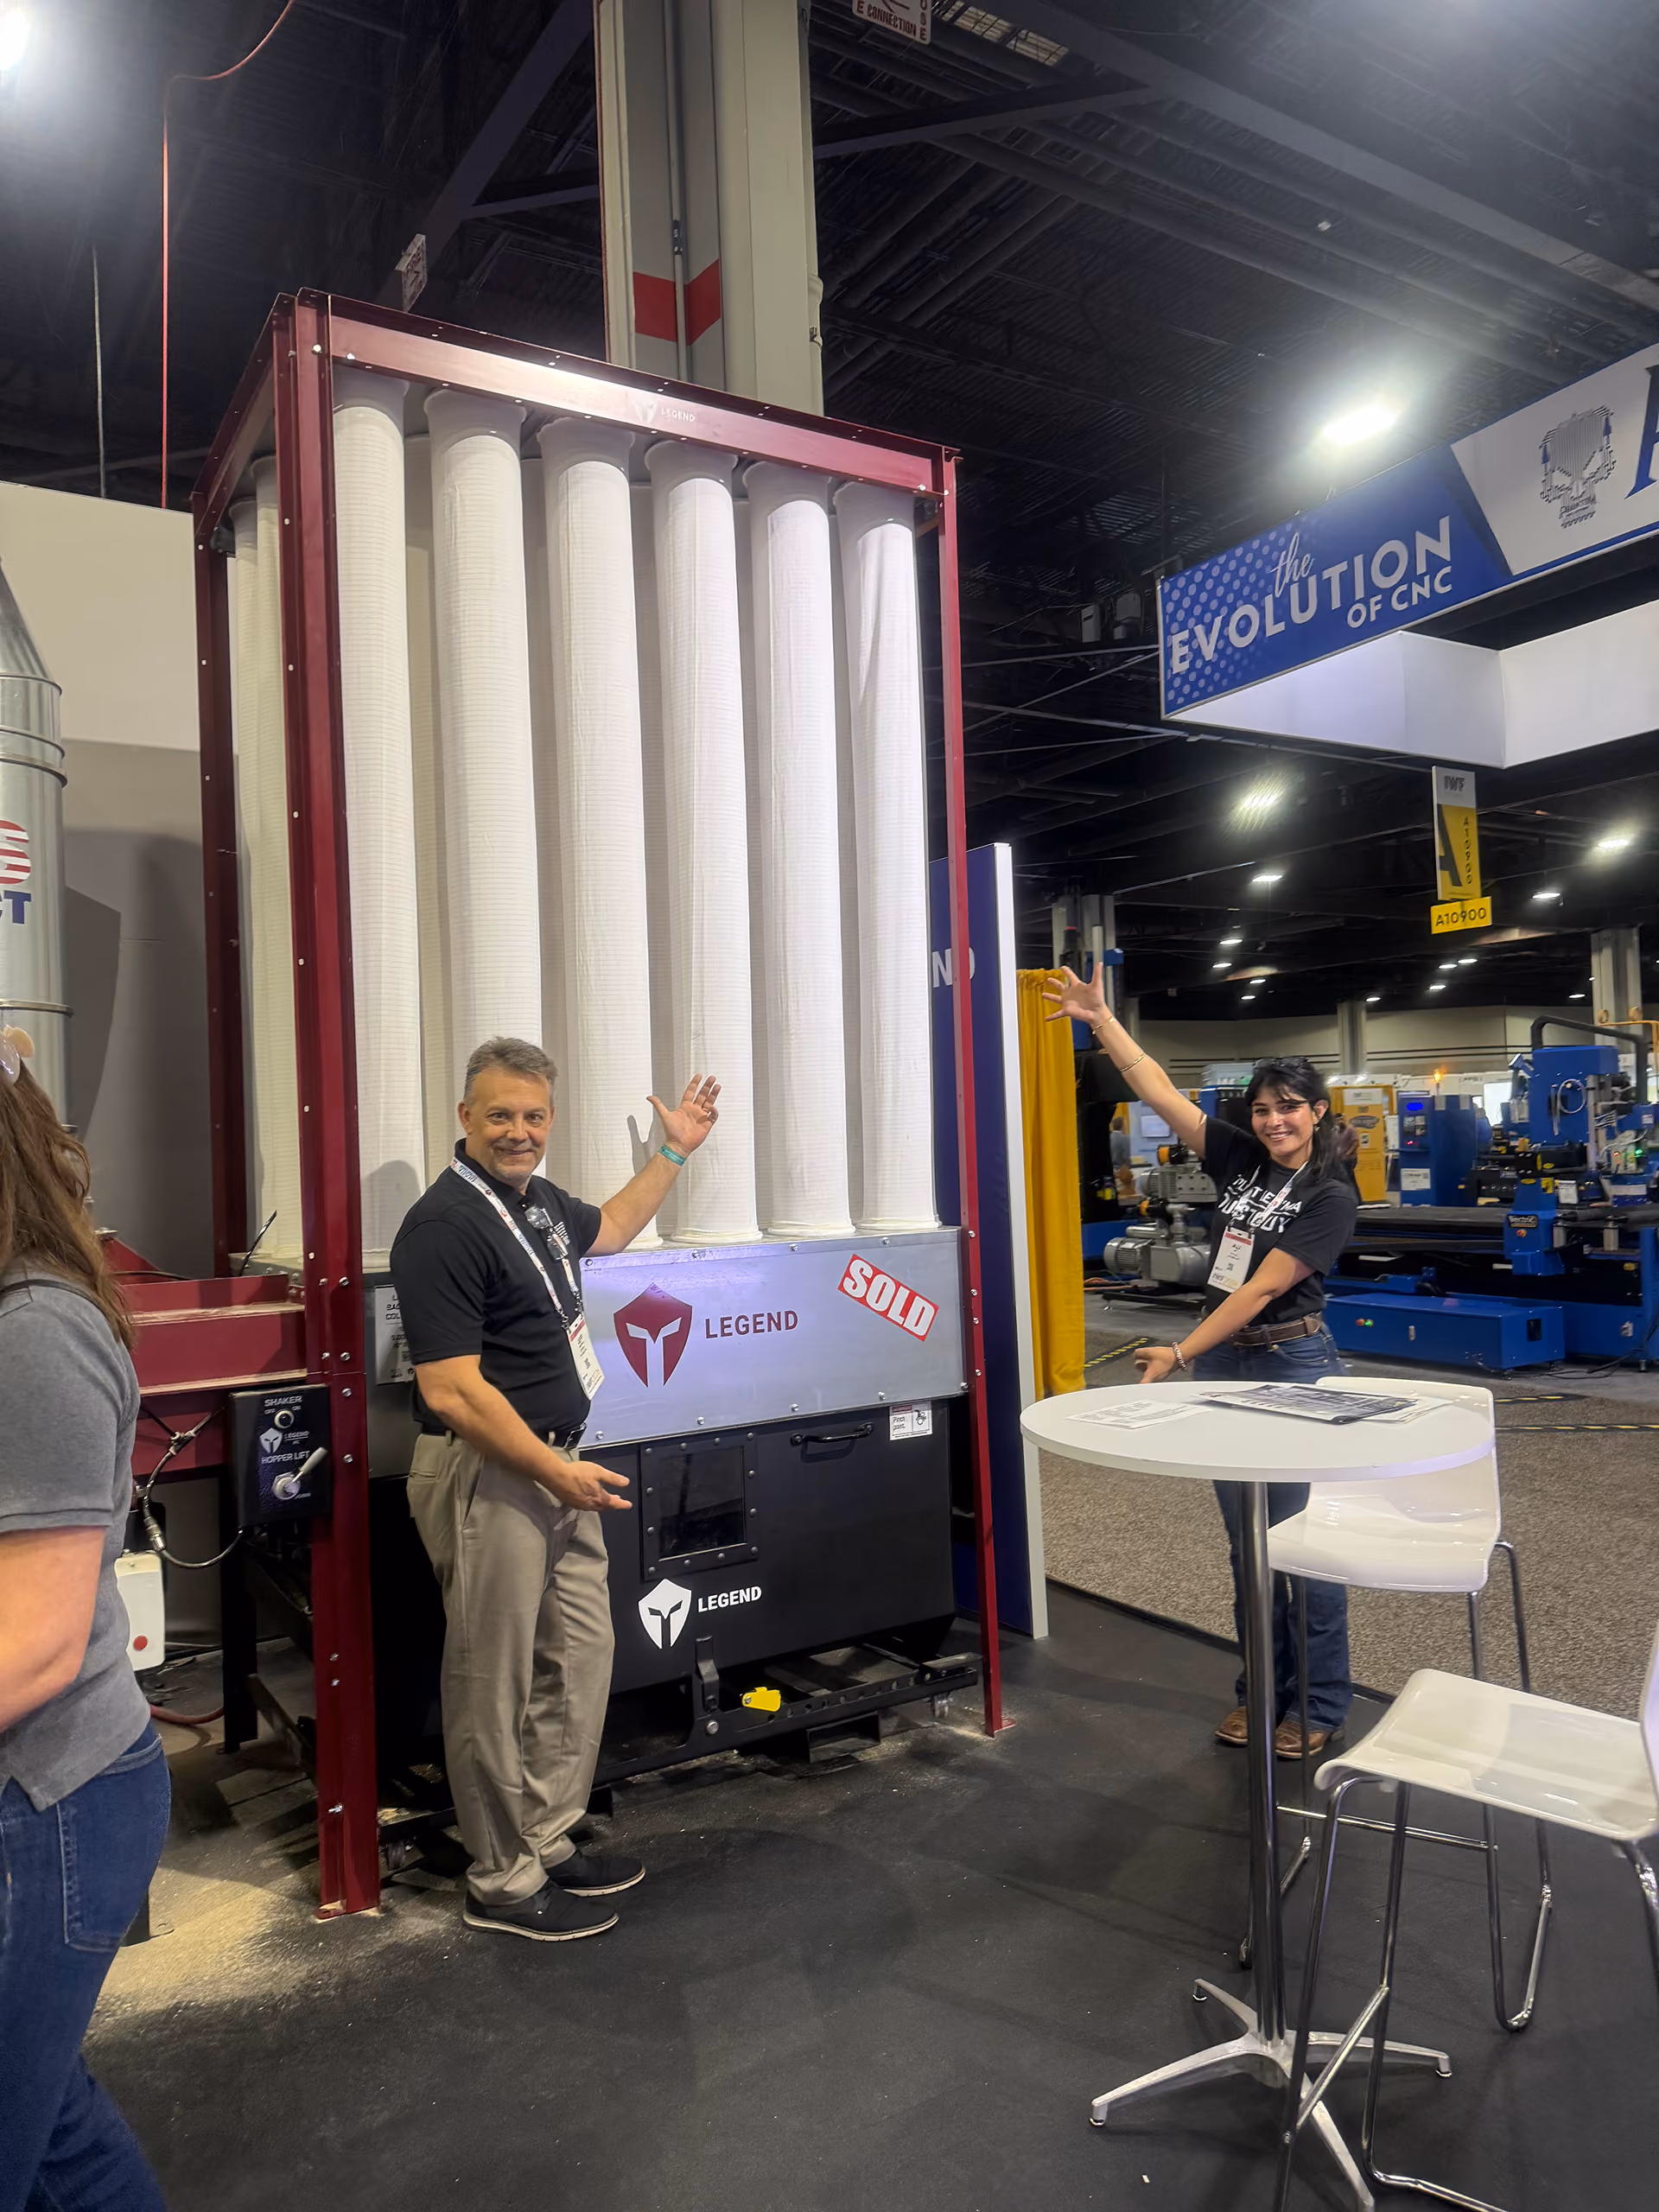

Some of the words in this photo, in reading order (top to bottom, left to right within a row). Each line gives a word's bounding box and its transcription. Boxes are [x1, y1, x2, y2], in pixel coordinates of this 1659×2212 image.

[867, 3, 917, 37] CONNECTION
[1269, 531, 1315, 598] the
[1172, 515, 1452, 675] EVOLUTION
[1347, 594, 1382, 629] OF
[1391, 565, 1452, 612] CNC
[1434, 907, 1487, 927] A10900
[842, 1258, 936, 1337] SOLD
[705, 1310, 799, 1339] LEGEND
[264, 1395, 303, 1408] SHAKER
[261, 1453, 292, 1465] HOPPER
[293, 1450, 311, 1461] LIFT
[697, 1586, 763, 1613] LEGEND
